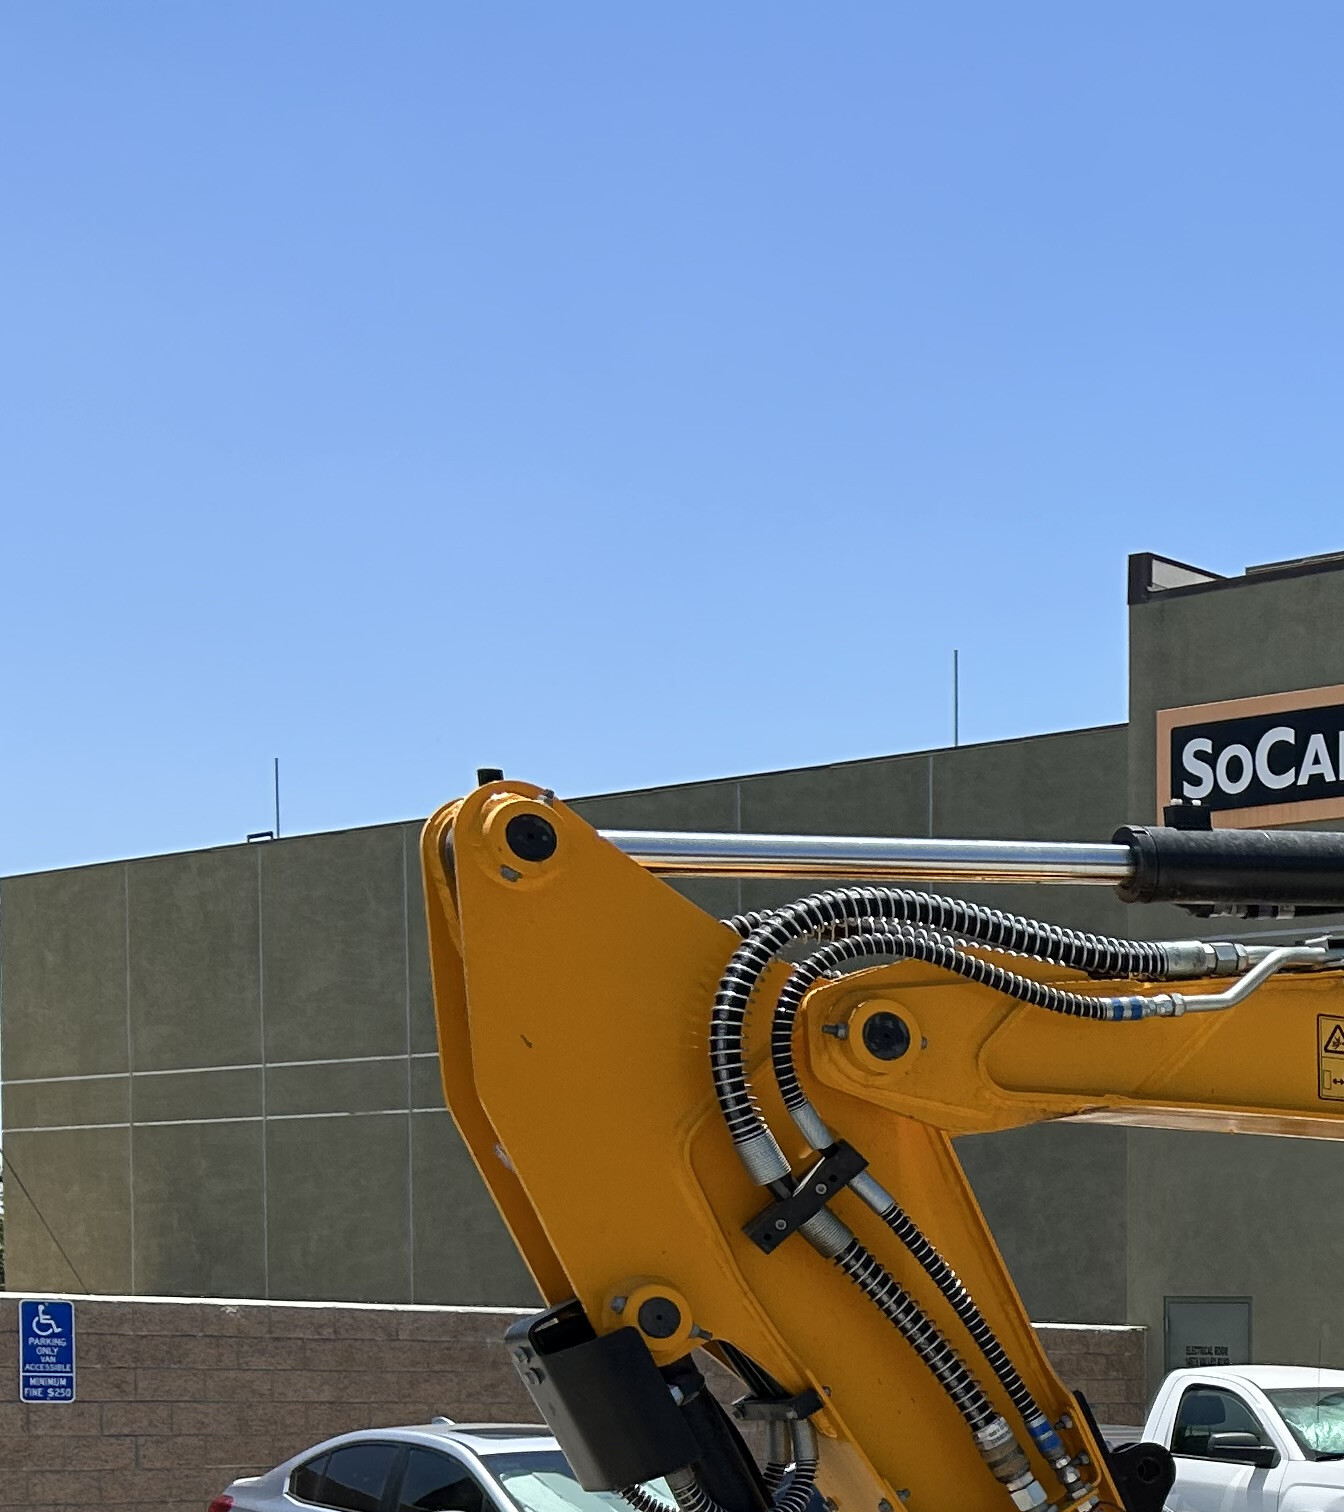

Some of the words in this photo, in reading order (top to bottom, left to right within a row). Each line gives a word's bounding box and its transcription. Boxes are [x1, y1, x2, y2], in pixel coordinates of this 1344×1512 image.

[28, 1336, 67, 1347] PARKING
[36, 1347, 59, 1356] ONLY
[24, 1363, 72, 1372] ACCESSIBLE
[29, 1377, 67, 1386] MINIMUM
[24, 1388, 44, 1397] FINE
[47, 1388, 72, 1397] $250
